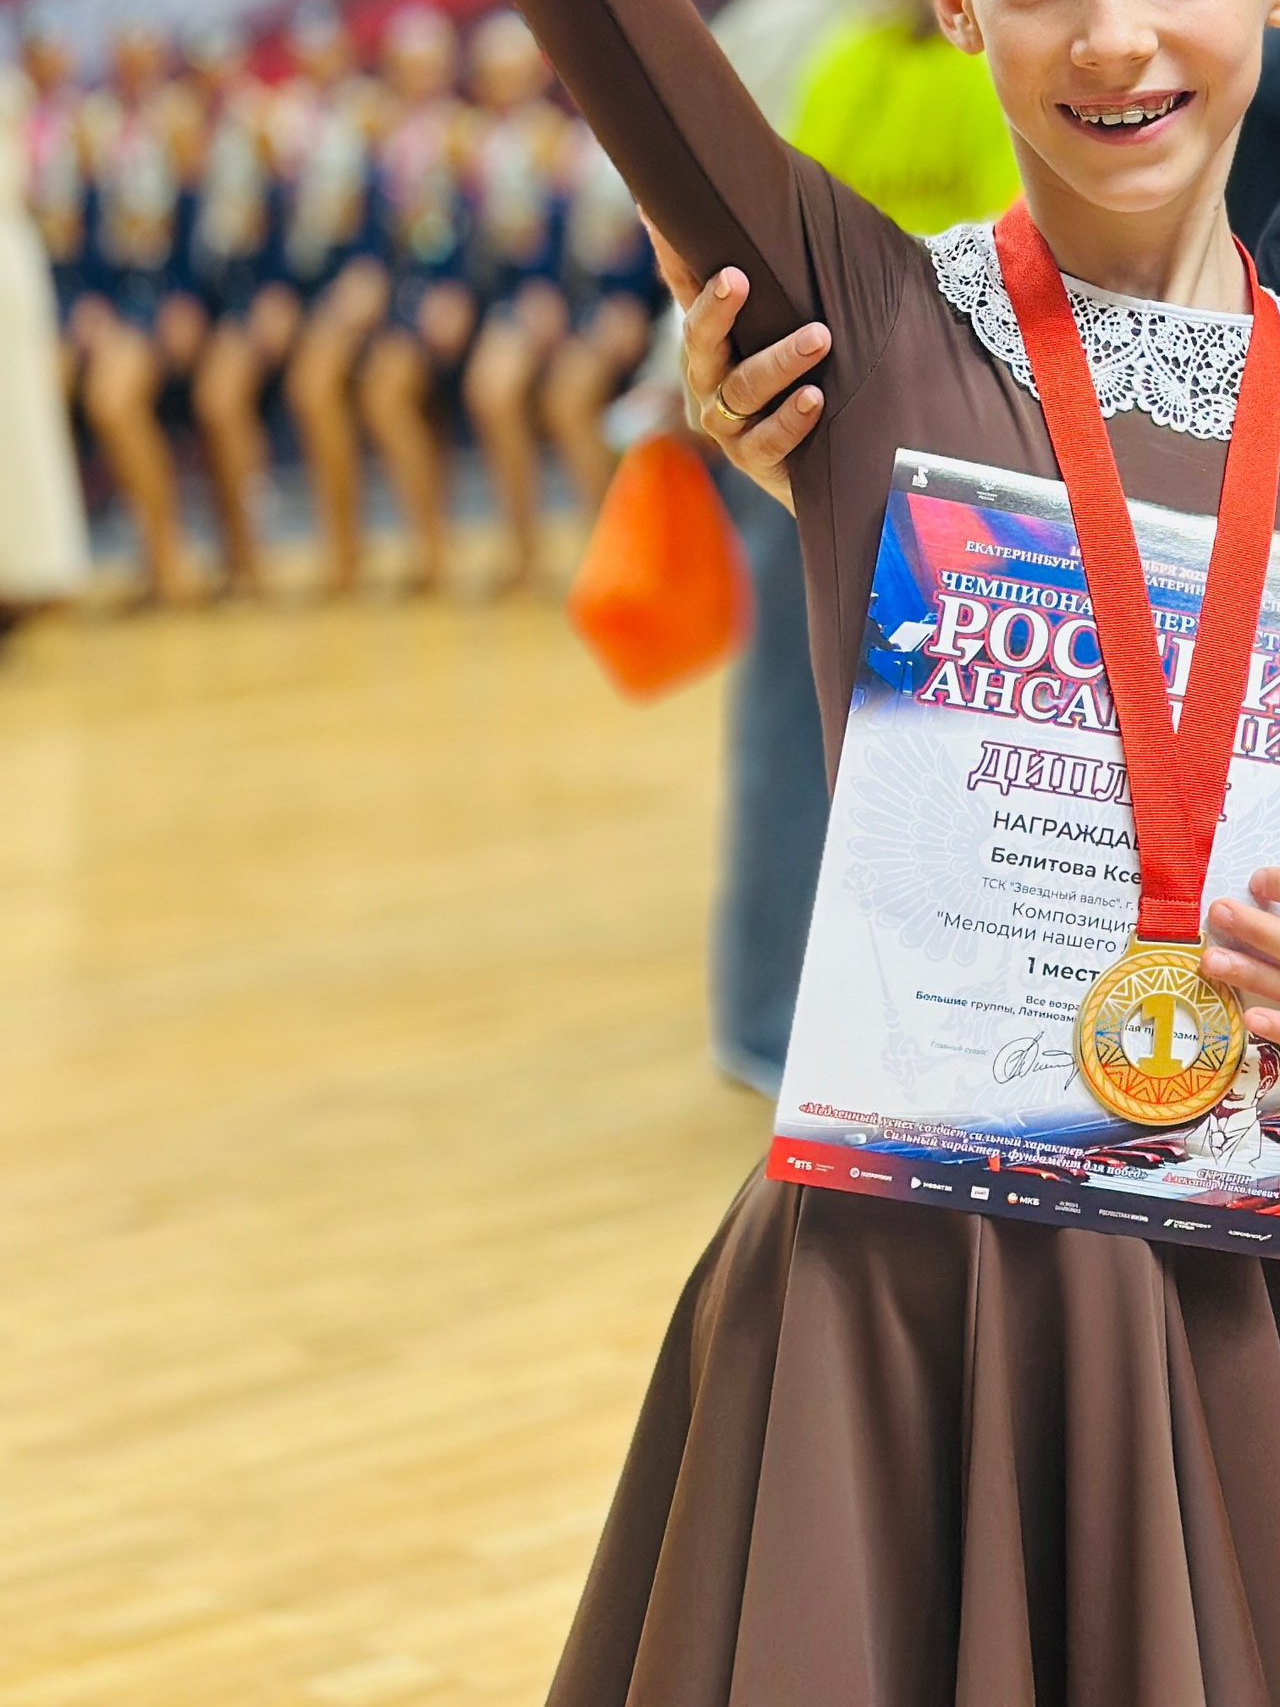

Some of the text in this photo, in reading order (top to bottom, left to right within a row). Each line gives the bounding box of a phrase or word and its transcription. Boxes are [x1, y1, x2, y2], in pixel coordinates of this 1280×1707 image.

[965, 540, 1079, 571] ЕКАТЕРИНБУРГ
[940, 570, 1093, 616] ЧЕМПИОНА
[993, 810, 1139, 851] НАГРАЖДА
[991, 847, 1141, 885] Белитова Ксе
[982, 877, 1006, 892] ТСК
[1010, 882, 1076, 901] "Звездный
[937, 911, 1116, 953] "Мелодии нашего
[1027, 957, 1100, 982] 1 мест
[916, 991, 968, 1007] Большие
[971, 1000, 1015, 1015] группы,
[1026, 996, 1081, 1012] Все возра
[799, 1103, 878, 1125] «Медленный
[880, 1116, 915, 1131] успех
[918, 1122, 967, 1140] создает
[969, 1131, 1021, 1147] сильный
[884, 1129, 938, 1147] Сильный
[942, 1138, 999, 1158] характер
[1083, 1162, 1104, 1173] для
